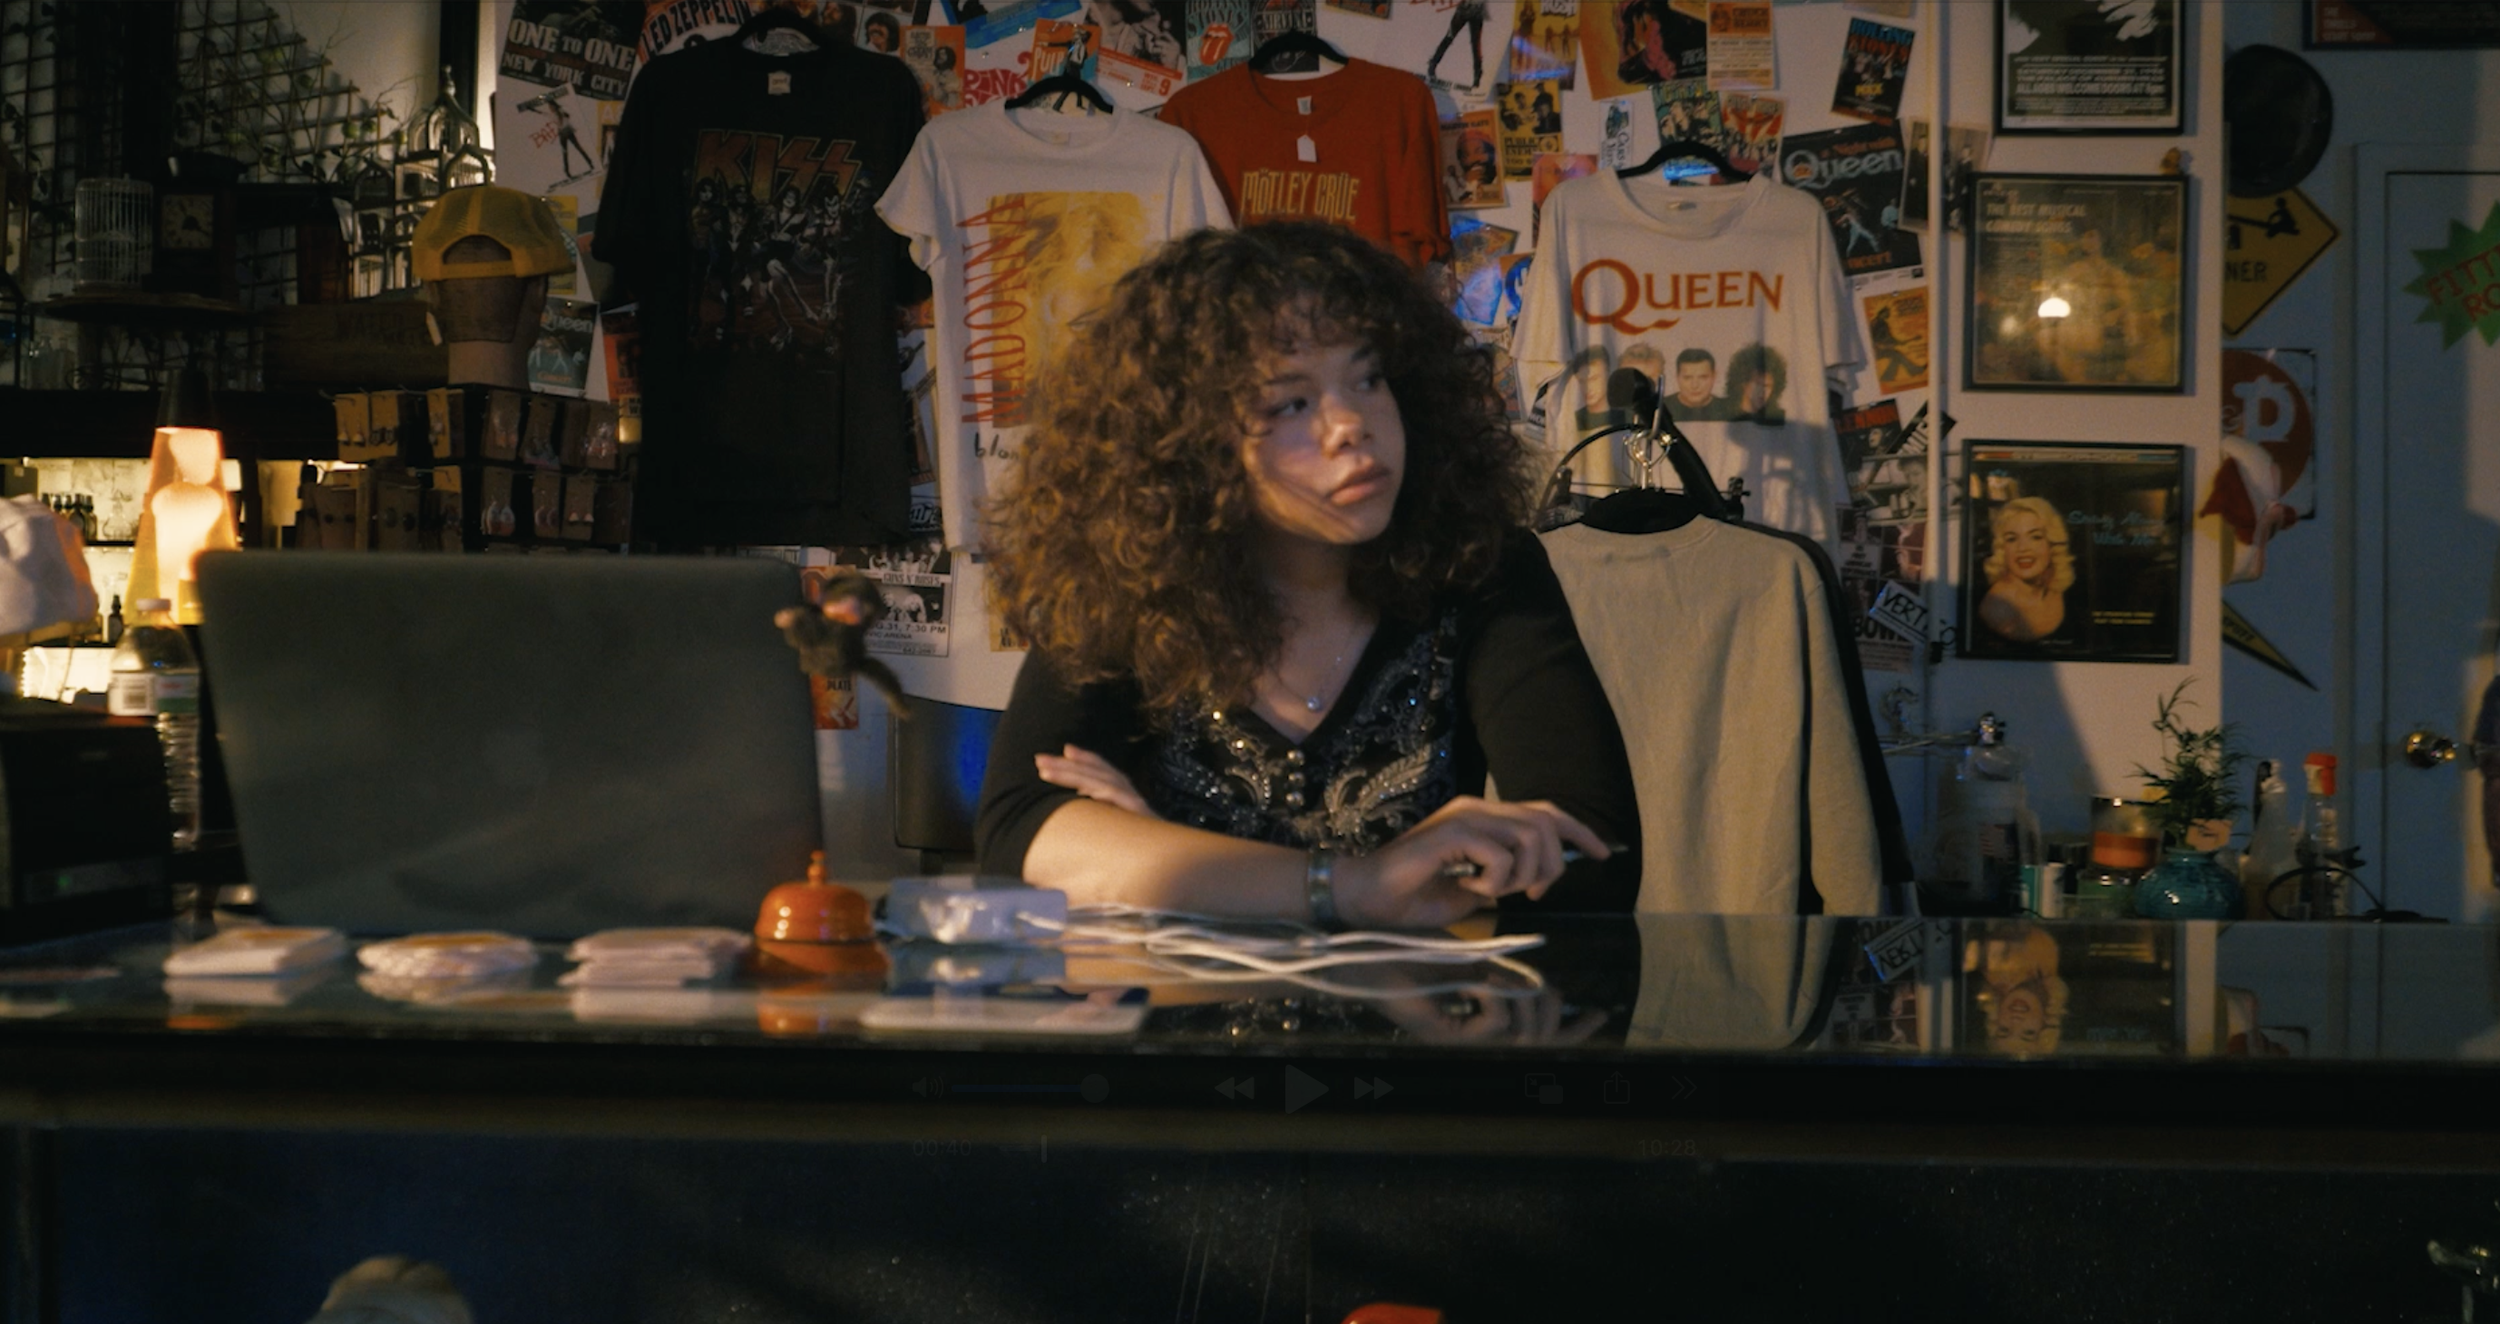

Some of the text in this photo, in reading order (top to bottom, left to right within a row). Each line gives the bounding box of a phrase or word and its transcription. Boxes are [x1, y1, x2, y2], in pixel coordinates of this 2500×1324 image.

[508, 19, 636, 72] ONE TO ONE
[502, 52, 628, 96] NEW YORK CITY
[1031, 47, 1067, 82] PULP
[964, 68, 1027, 99] PINK
[1158, 78, 1172, 96] 9
[691, 128, 863, 206] KISS
[1784, 149, 1904, 190] Queen
[1241, 167, 1361, 225] MÖTLEY CRÜE
[2037, 203, 2087, 217] MUSICAL
[2424, 245, 2500, 307] FITT
[539, 308, 593, 333] Queen
[955, 195, 1028, 424] MADONNA
[883, 573, 904, 584] GUNS
[915, 575, 940, 586] ROSES
[883, 632, 913, 640] ARENA
[905, 623, 927, 633] 7:30
[930, 625, 947, 634] PM
